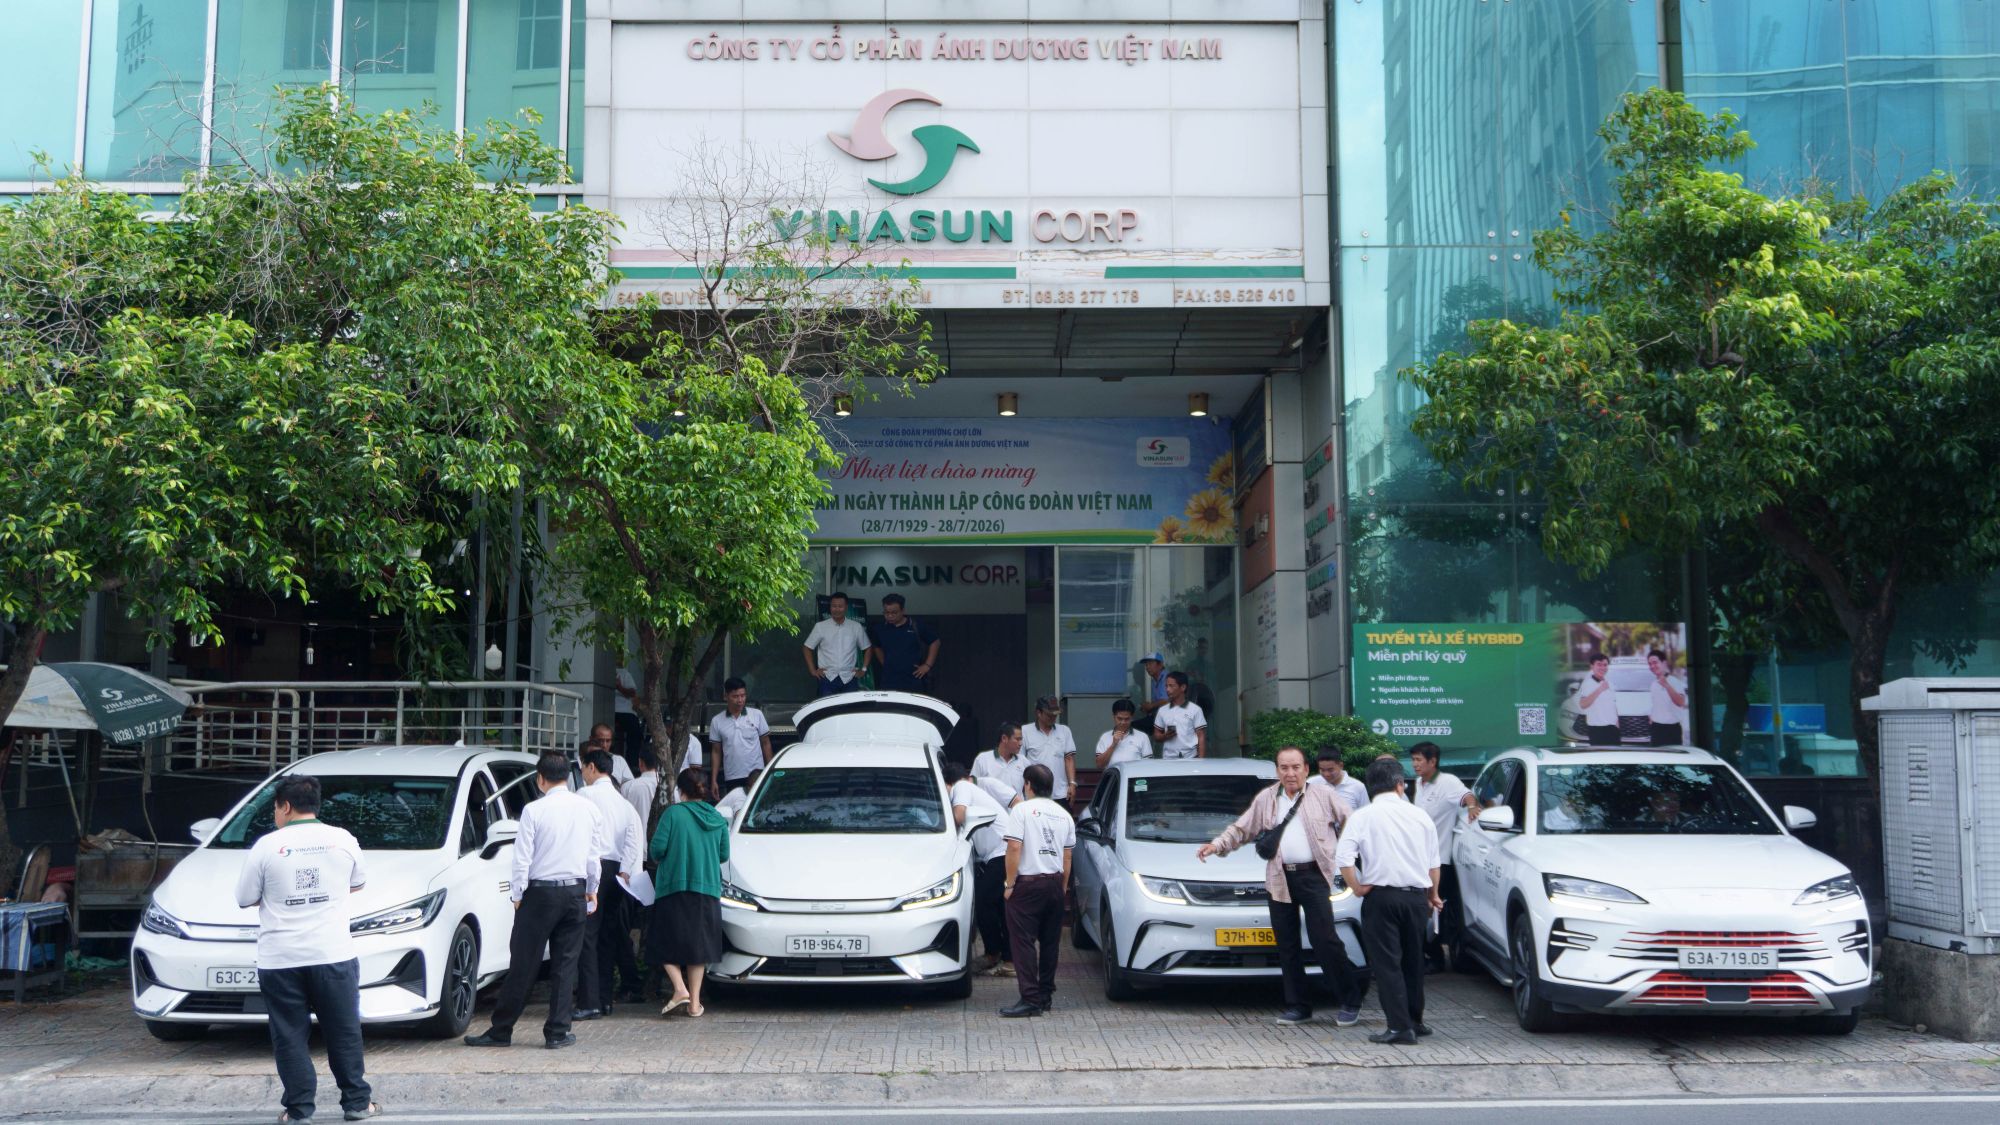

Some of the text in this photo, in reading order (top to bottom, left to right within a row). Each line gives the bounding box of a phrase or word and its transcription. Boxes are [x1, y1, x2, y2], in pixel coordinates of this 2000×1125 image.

[687, 24, 1222, 66] CÔNG TY CỔ PHẦN ÁNH DƯƠNG VIỆT NAM
[772, 209, 1143, 243] VINASUN CORP.
[828, 454, 1037, 487] Nhiệt liệt chào mừng
[844, 490, 886, 511] NGÀY
[890, 490, 945, 511] THÀNH
[949, 490, 978, 515] LẬP
[983, 490, 1025, 511] CÔNG
[1029, 490, 1074, 511] ĐOÀN
[1077, 490, 1115, 515] VIỆT
[1117, 494, 1152, 511] NAM
[861, 519, 928, 534] (28/7/1929
[937, 519, 1005, 534] 28/7/2026)
[960, 564, 1020, 586] CORP.
[1366, 628, 1524, 645] TUYỂN TÀI XẾ HYBRID
[1368, 648, 1467, 663] Miễn phí ký quỹ
[102, 696, 143, 710] VINASUN
[143, 693, 158, 702] APP
[134, 724, 147, 738] 38
[147, 721, 158, 734] 27
[159, 718, 170, 731] 27
[1394, 727, 1450, 735] 0393 27 27 27
[793, 938, 862, 951] 51B-964.78
[1687, 951, 1769, 965] 63A-719.05
[215, 971, 260, 984] 63C-2
